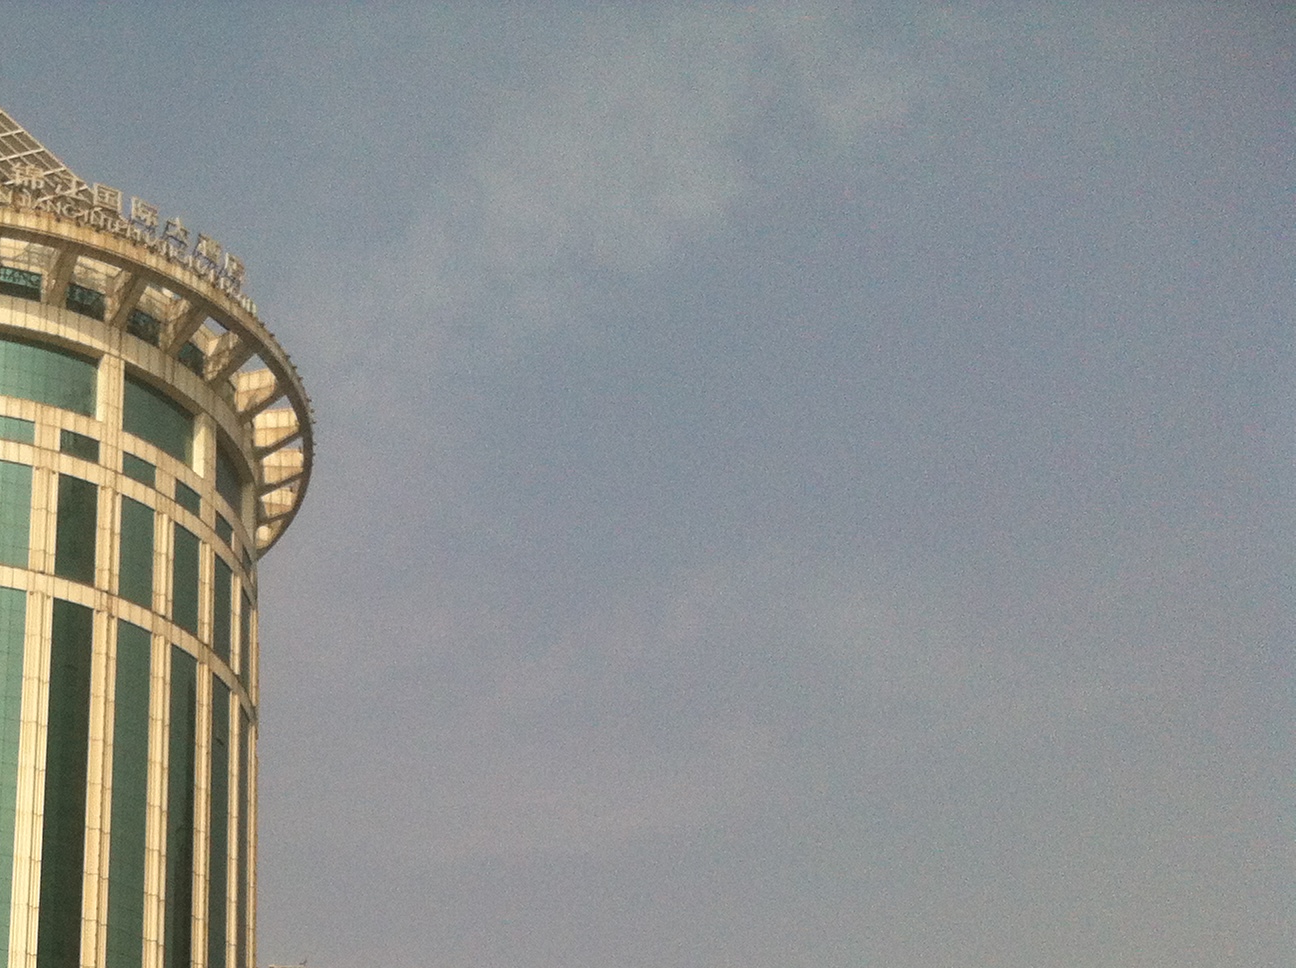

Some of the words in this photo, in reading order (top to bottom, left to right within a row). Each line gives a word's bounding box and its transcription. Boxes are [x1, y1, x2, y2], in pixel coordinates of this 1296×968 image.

[10, 161, 246, 281] 锦江国际大酒店
